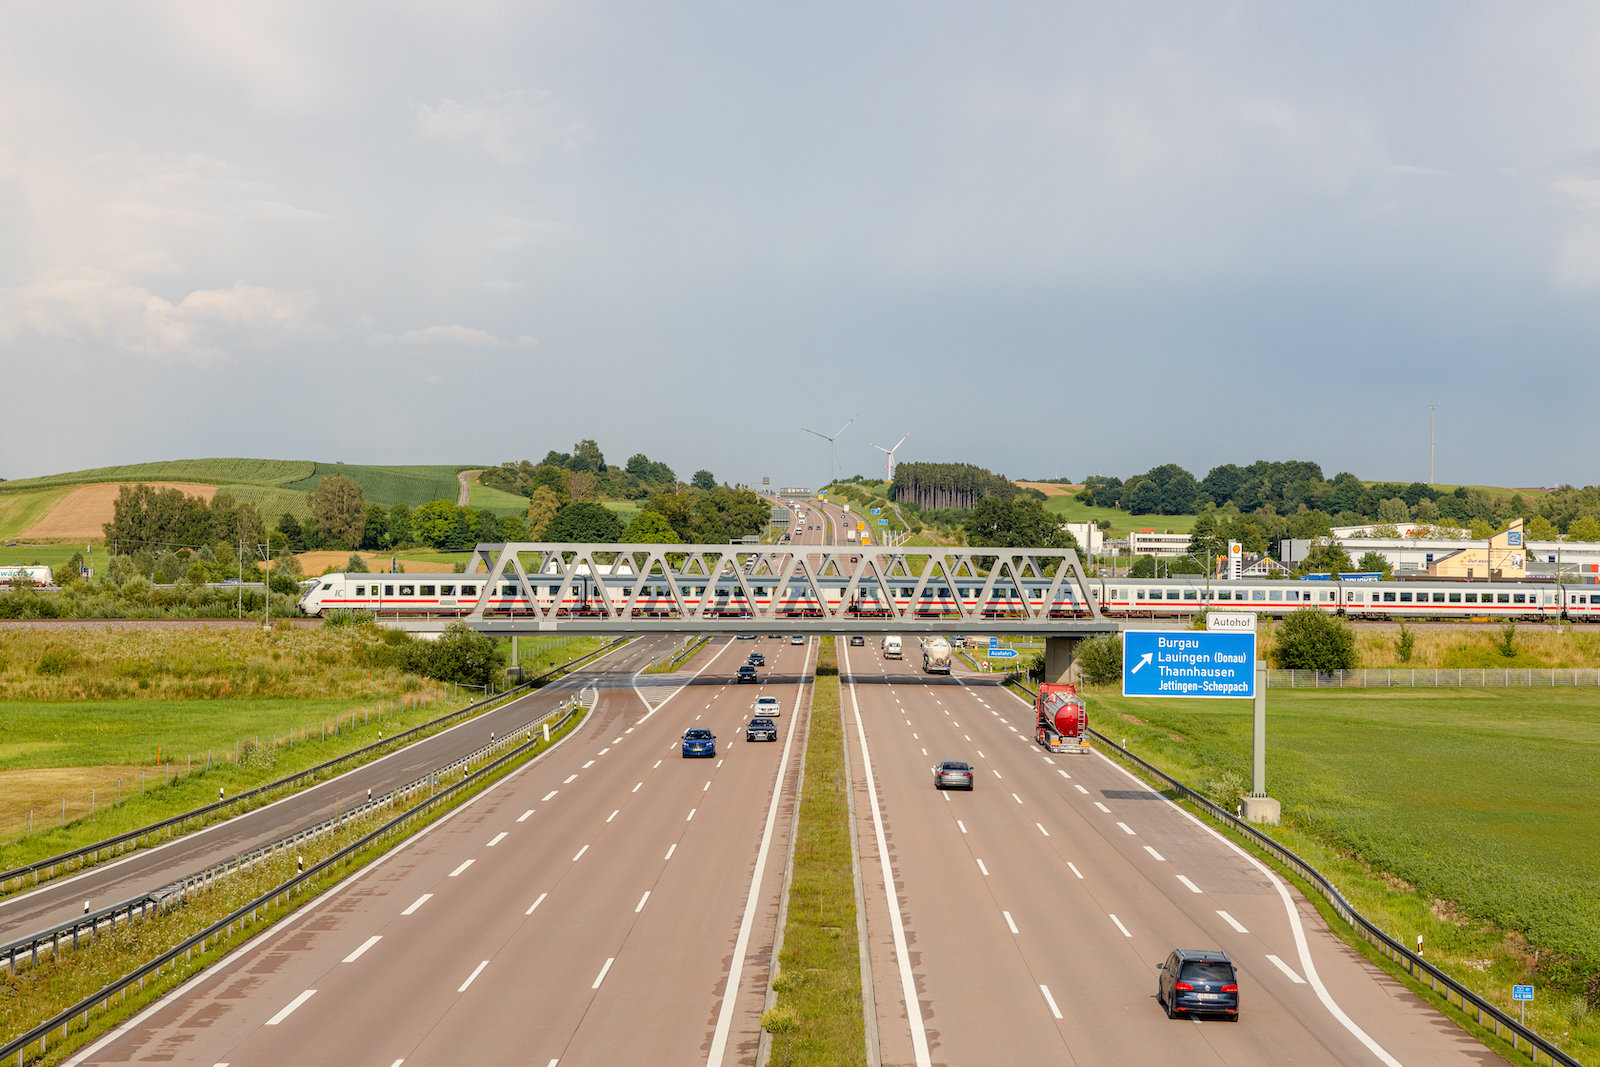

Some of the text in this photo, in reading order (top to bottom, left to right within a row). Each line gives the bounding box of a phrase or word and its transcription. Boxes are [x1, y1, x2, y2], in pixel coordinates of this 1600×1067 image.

[335, 589, 344, 597] IC
[1213, 618, 1251, 627] Autohof
[1158, 637, 1199, 650] Burgau
[1158, 652, 1247, 665] Lauingen (Donau)
[1158, 666, 1235, 677] Thannhausen
[1158, 680, 1248, 693] Jettingen-Scheppach
